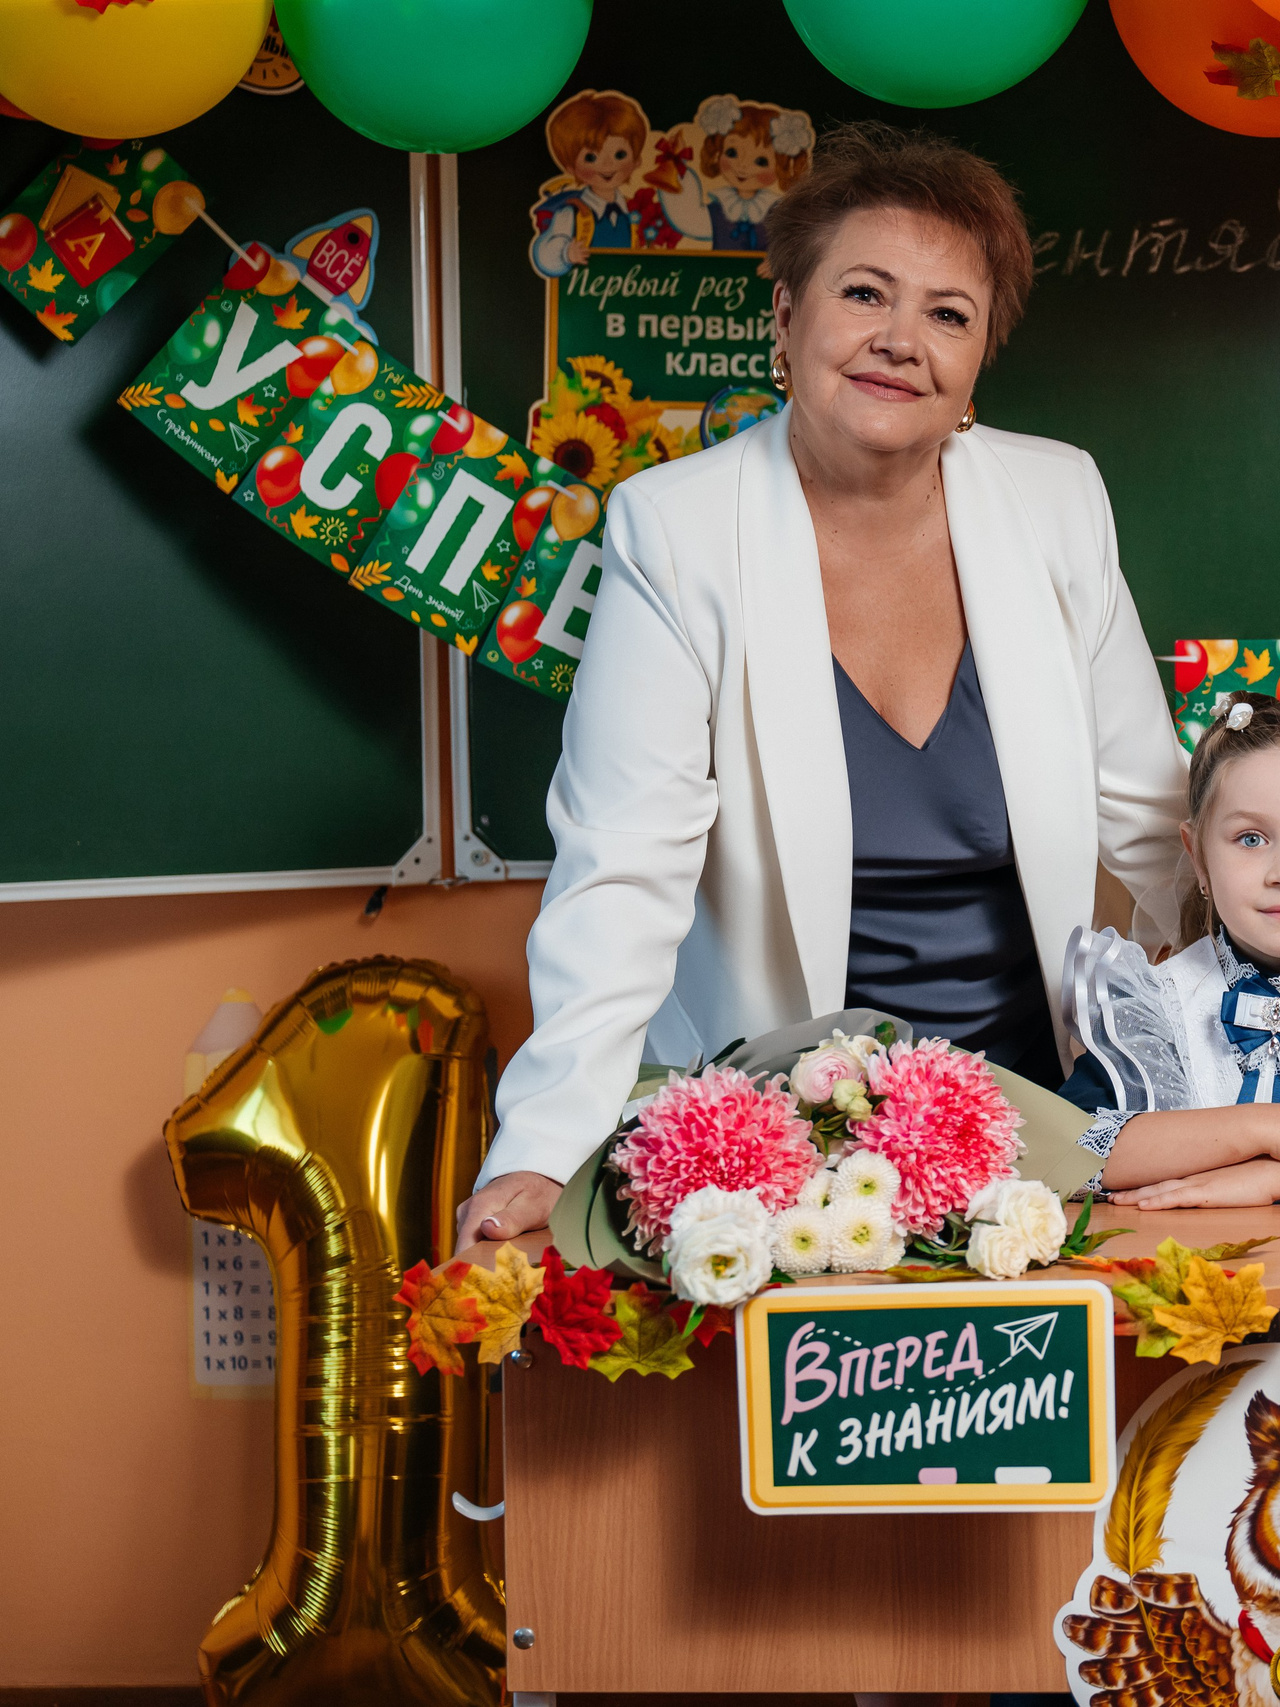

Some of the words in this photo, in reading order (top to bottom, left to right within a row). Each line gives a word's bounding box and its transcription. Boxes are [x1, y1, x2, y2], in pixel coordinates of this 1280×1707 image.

[312, 238, 363, 289] ВСЁ
[567, 264, 684, 312] Первый
[691, 276, 749, 311] раз
[606, 313, 626, 338] в
[638, 309, 777, 348] первый
[394, 574, 424, 599] День
[202, 1230, 209, 1245] 1
[202, 1256, 209, 1271] 1
[233, 1255, 243, 1271] 6
[203, 1281, 209, 1296] 1
[233, 1280, 243, 1296] 7
[202, 1305, 210, 1320] 1
[233, 1305, 243, 1321] 8
[203, 1330, 210, 1346] 1
[234, 1330, 244, 1346] 9
[204, 1355, 210, 1371] 1
[229, 1355, 248, 1371] 10
[264, 1355, 275, 1371] 1
[835, 1369, 1074, 1466] ЗНАНИЯМ!
